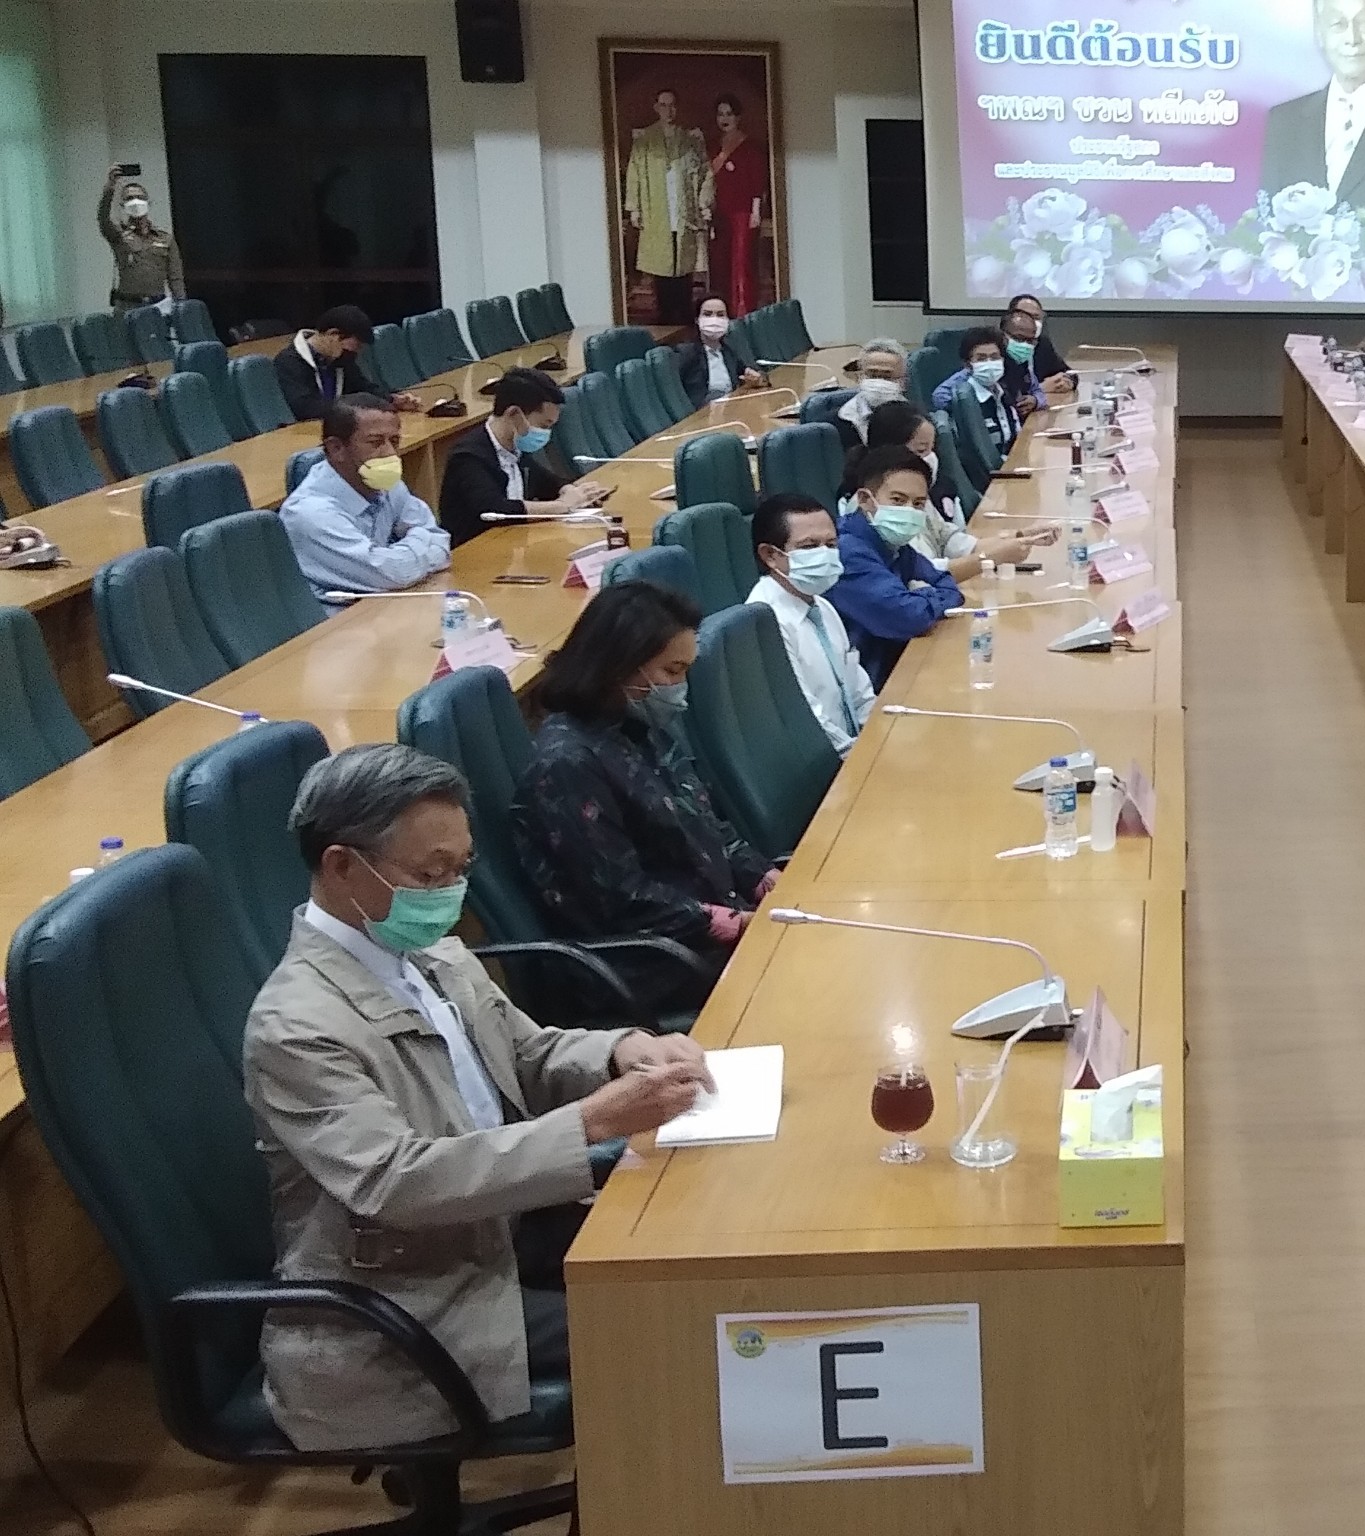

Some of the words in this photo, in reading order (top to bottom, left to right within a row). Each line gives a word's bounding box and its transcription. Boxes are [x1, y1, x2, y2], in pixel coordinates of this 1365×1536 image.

[978, 20, 1237, 67] ยินดีต้อนรับ
[1072, 96, 1133, 123] ชวน
[819, 1340, 889, 1450] E
